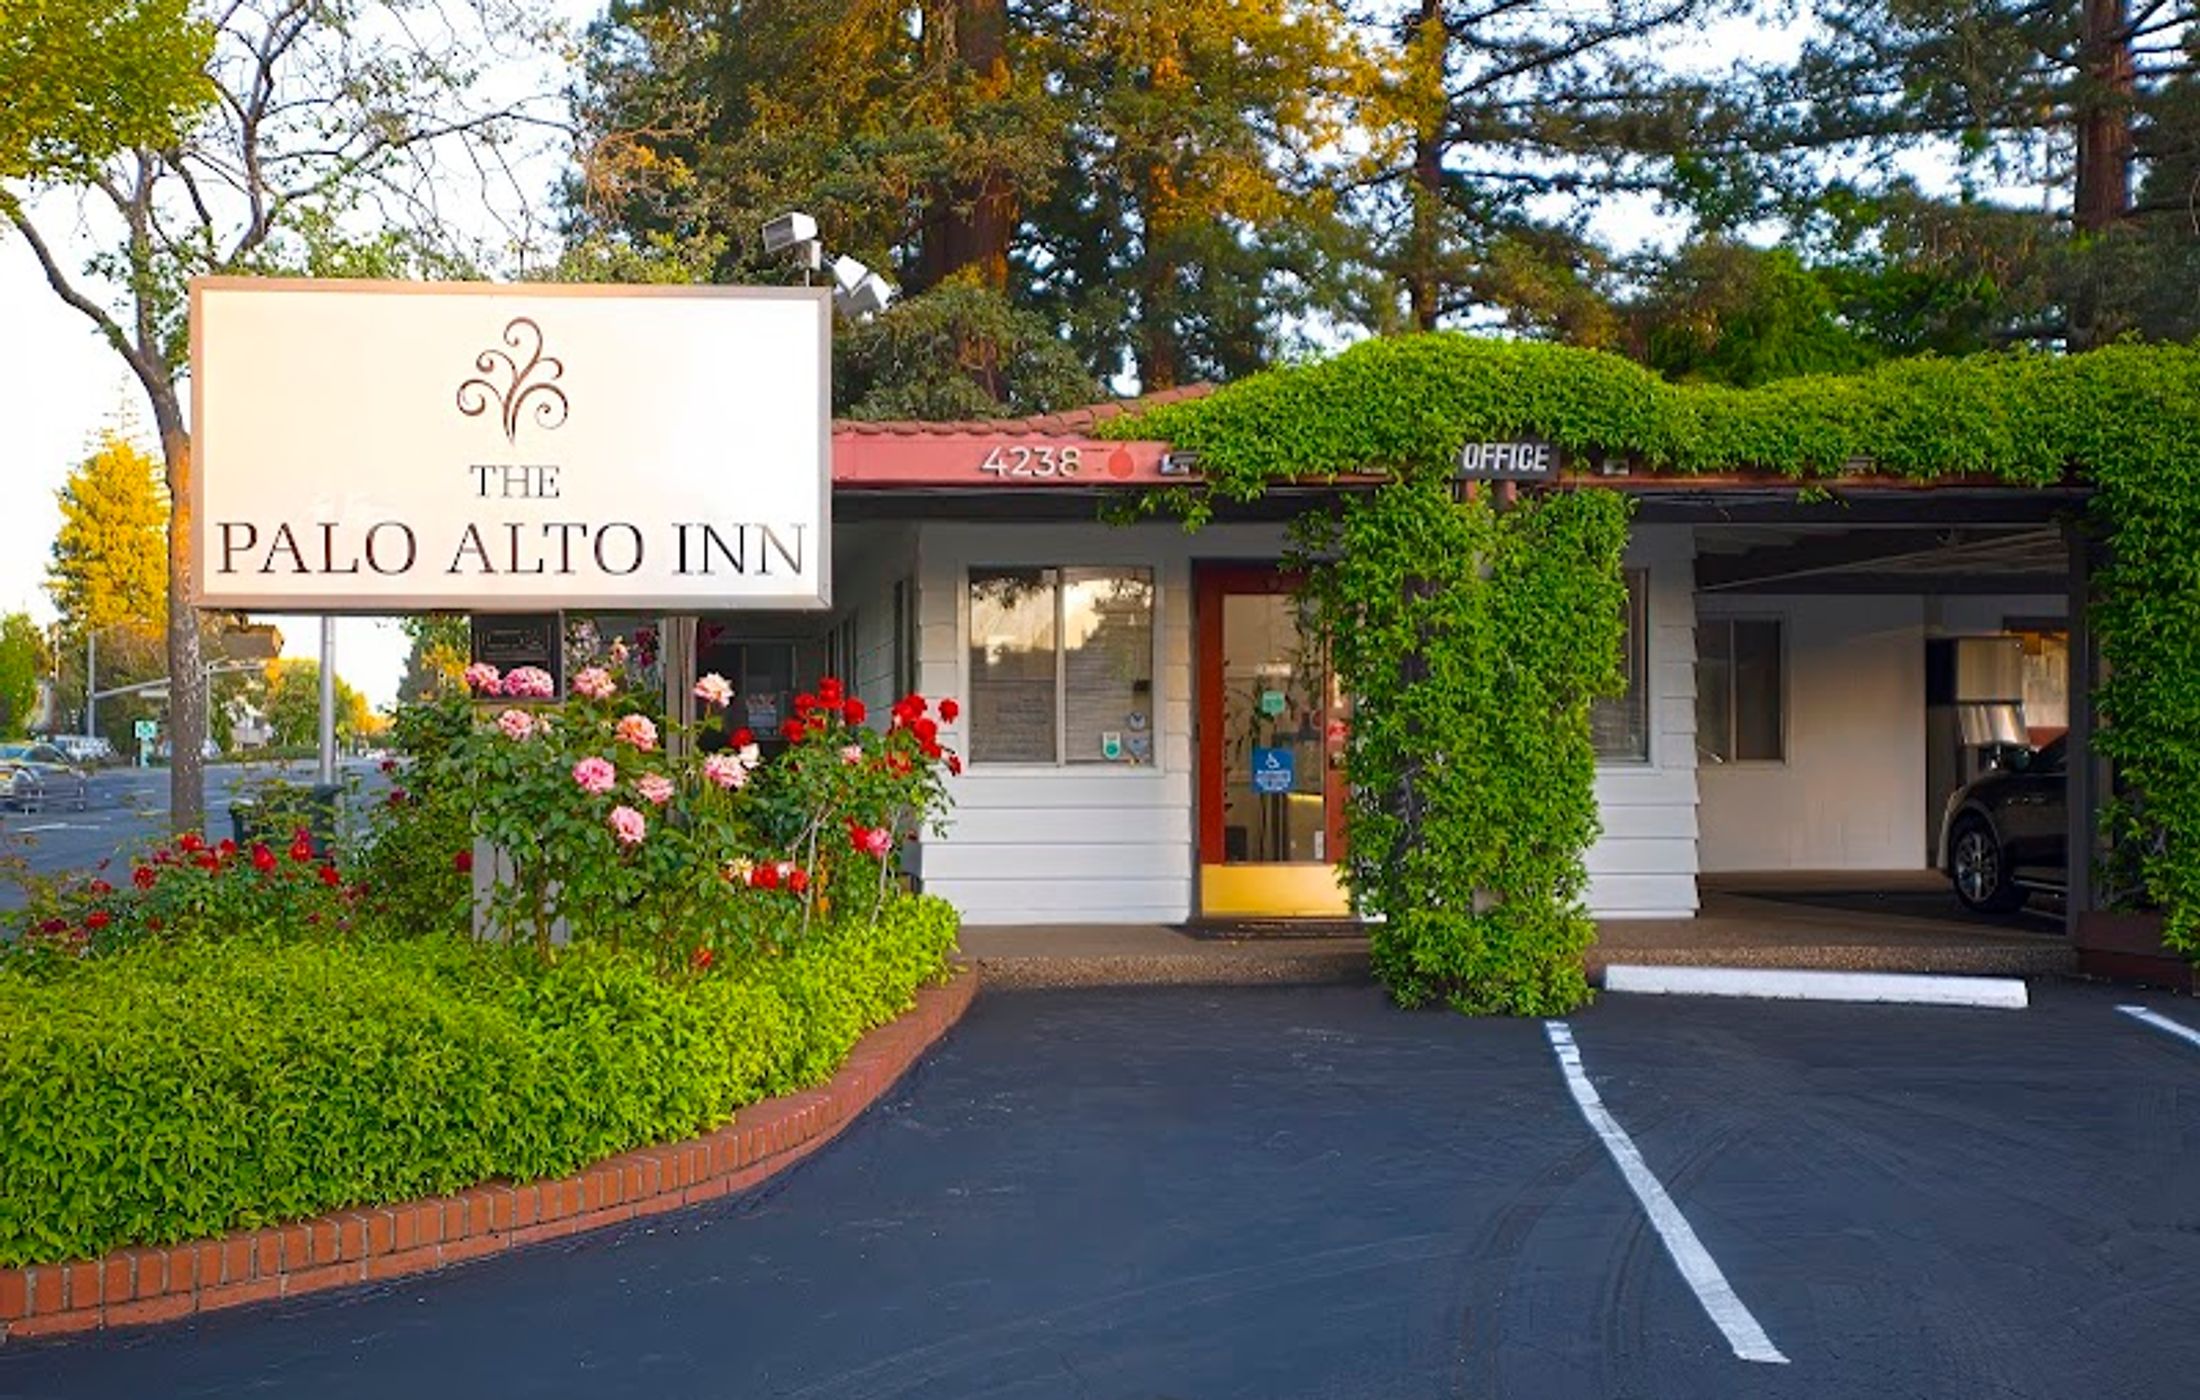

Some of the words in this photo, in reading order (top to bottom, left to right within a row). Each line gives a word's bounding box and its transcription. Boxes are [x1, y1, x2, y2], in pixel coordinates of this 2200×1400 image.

[982, 445, 1083, 476] 4238
[1462, 442, 1550, 473] OFFICE
[470, 465, 561, 498] THE
[216, 522, 418, 575] PALO
[445, 522, 645, 575] ALTO
[672, 523, 808, 577] INN
